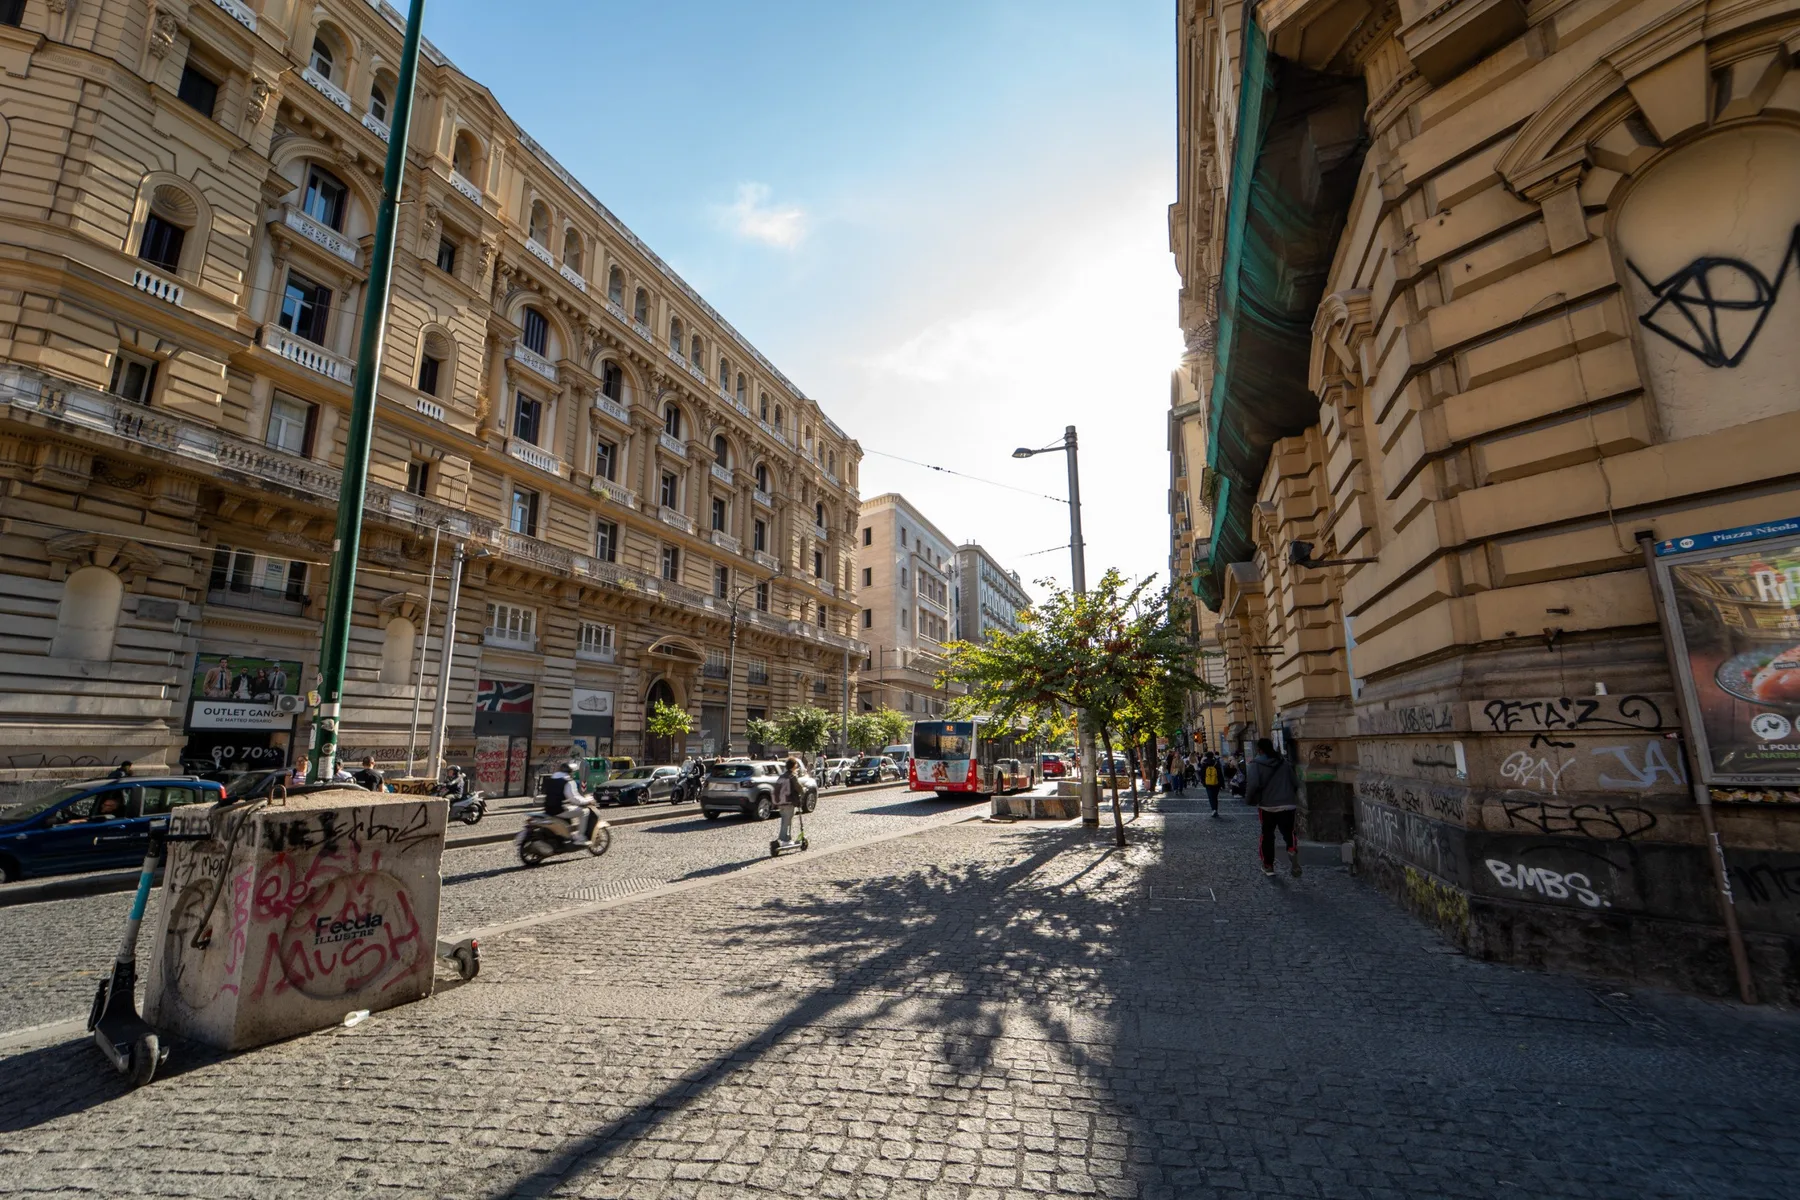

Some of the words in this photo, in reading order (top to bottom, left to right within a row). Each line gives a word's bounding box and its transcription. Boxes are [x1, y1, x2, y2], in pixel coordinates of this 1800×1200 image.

[1712, 531, 1753, 542] Piazza
[1755, 523, 1798, 535] Nicola
[203, 707, 246, 717] OUTLET
[211, 745, 235, 758] 60
[241, 746, 273, 759] 70%
[314, 928, 375, 946] ILLUSTRE
